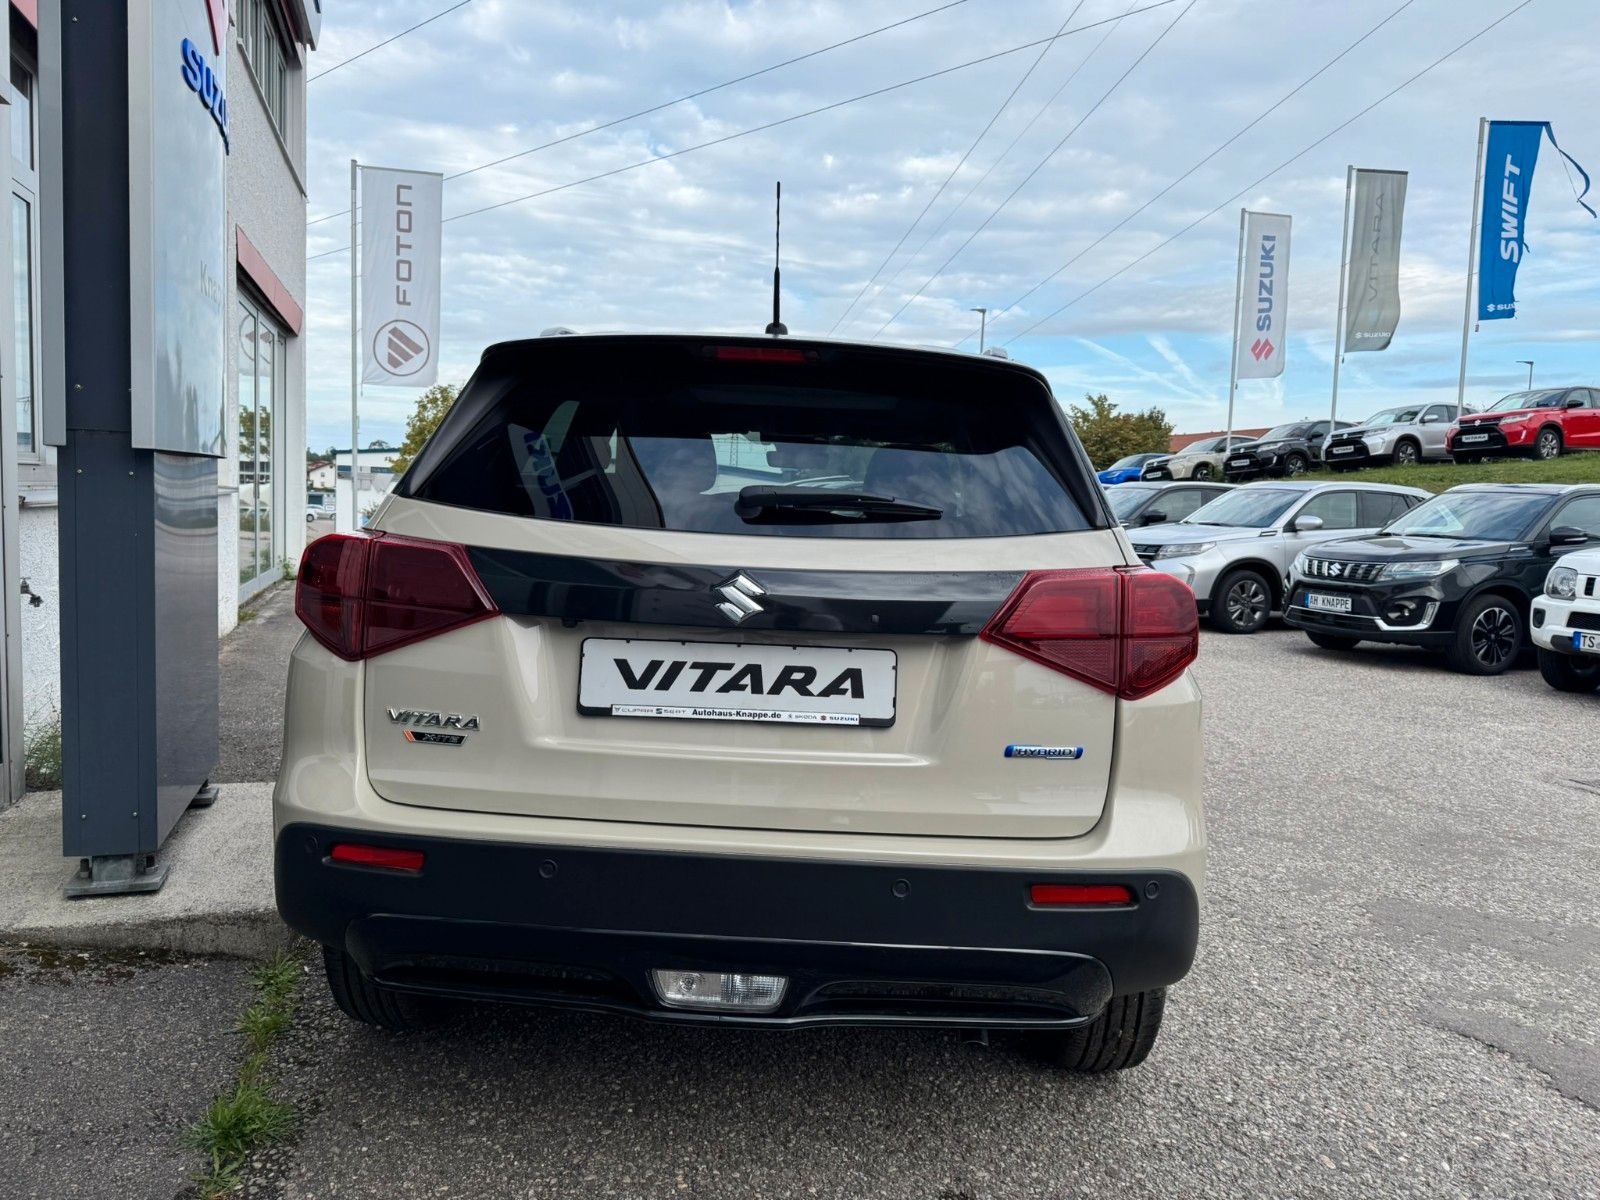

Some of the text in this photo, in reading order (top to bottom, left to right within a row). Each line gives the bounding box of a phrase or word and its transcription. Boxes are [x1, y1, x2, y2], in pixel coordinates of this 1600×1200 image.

[180, 37, 230, 156] SUZU
[1501, 153, 1521, 264] SWIFT
[396, 184, 412, 306] FOTON
[1368, 192, 1385, 303] VITARA
[1256, 234, 1277, 332] SUZUKI
[1322, 597, 1350, 609] KNAPPE
[1582, 635, 1595, 648] TS
[613, 658, 865, 699] VITARA
[386, 707, 480, 732] VITARA
[692, 709, 782, 719] Autohaus-Knappe.de
[1017, 748, 1073, 757] HYBRID
